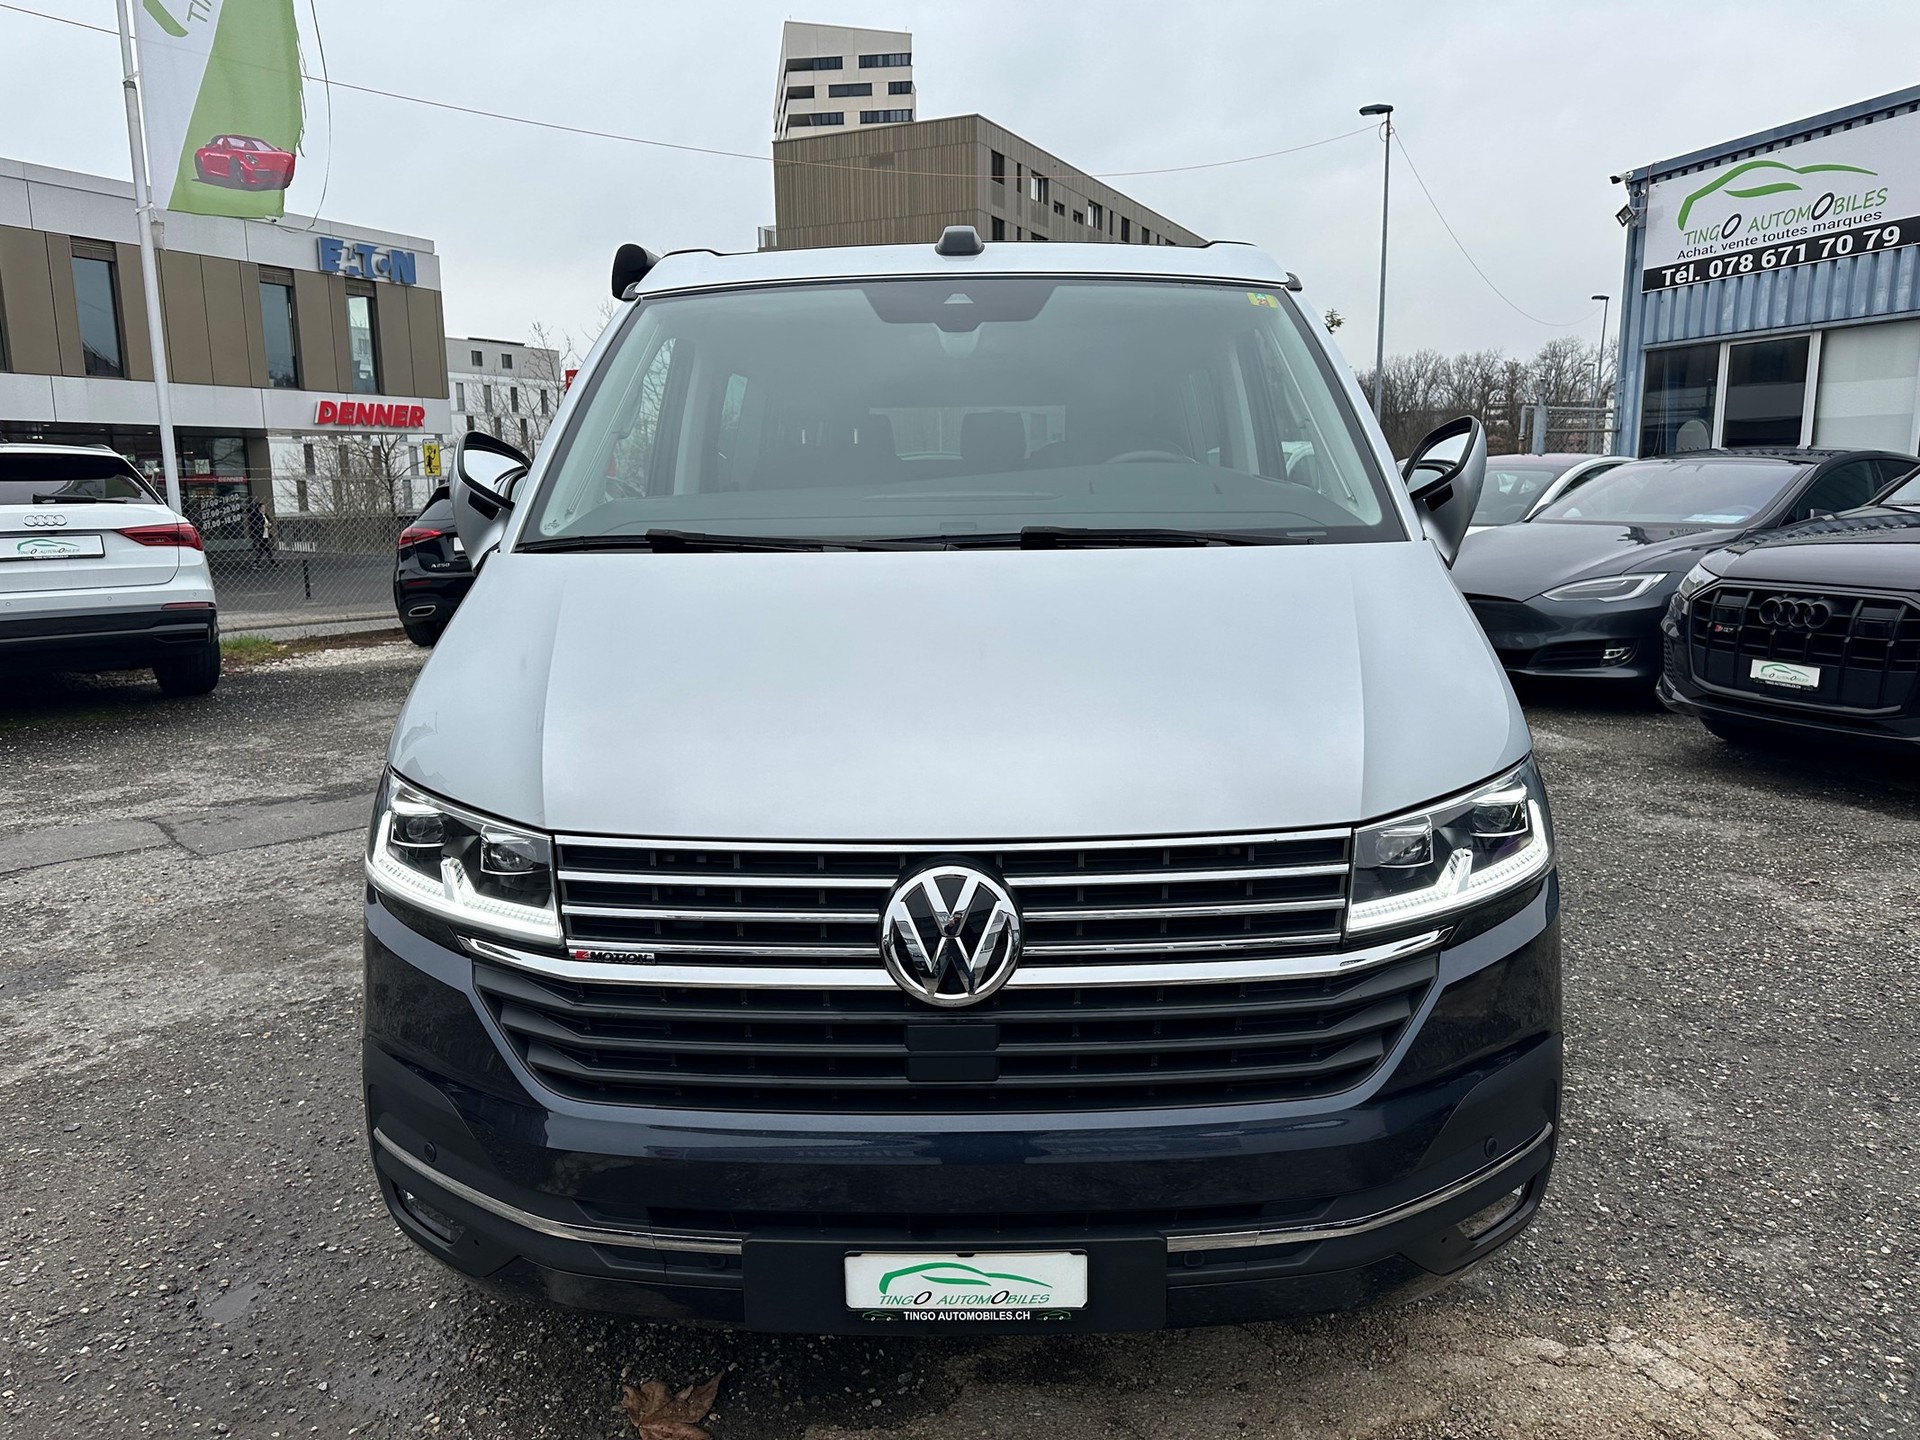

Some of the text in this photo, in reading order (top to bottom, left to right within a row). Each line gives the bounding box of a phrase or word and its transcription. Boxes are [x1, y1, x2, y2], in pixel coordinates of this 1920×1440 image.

[187, 0, 212, 22] TI
[1676, 211, 1883, 260] Achat, vente toutes marques
[1684, 187, 1888, 246] TINGO AUTOMOBILES
[317, 236, 416, 285] EATON
[1662, 225, 1901, 287] Tél. 078 671 70 79
[315, 400, 425, 427] DENNER
[879, 1290, 1050, 1305] TINGO AUTOMOBILES
[903, 1311, 1031, 1321] TINGO AUTOMOBILES.CH
